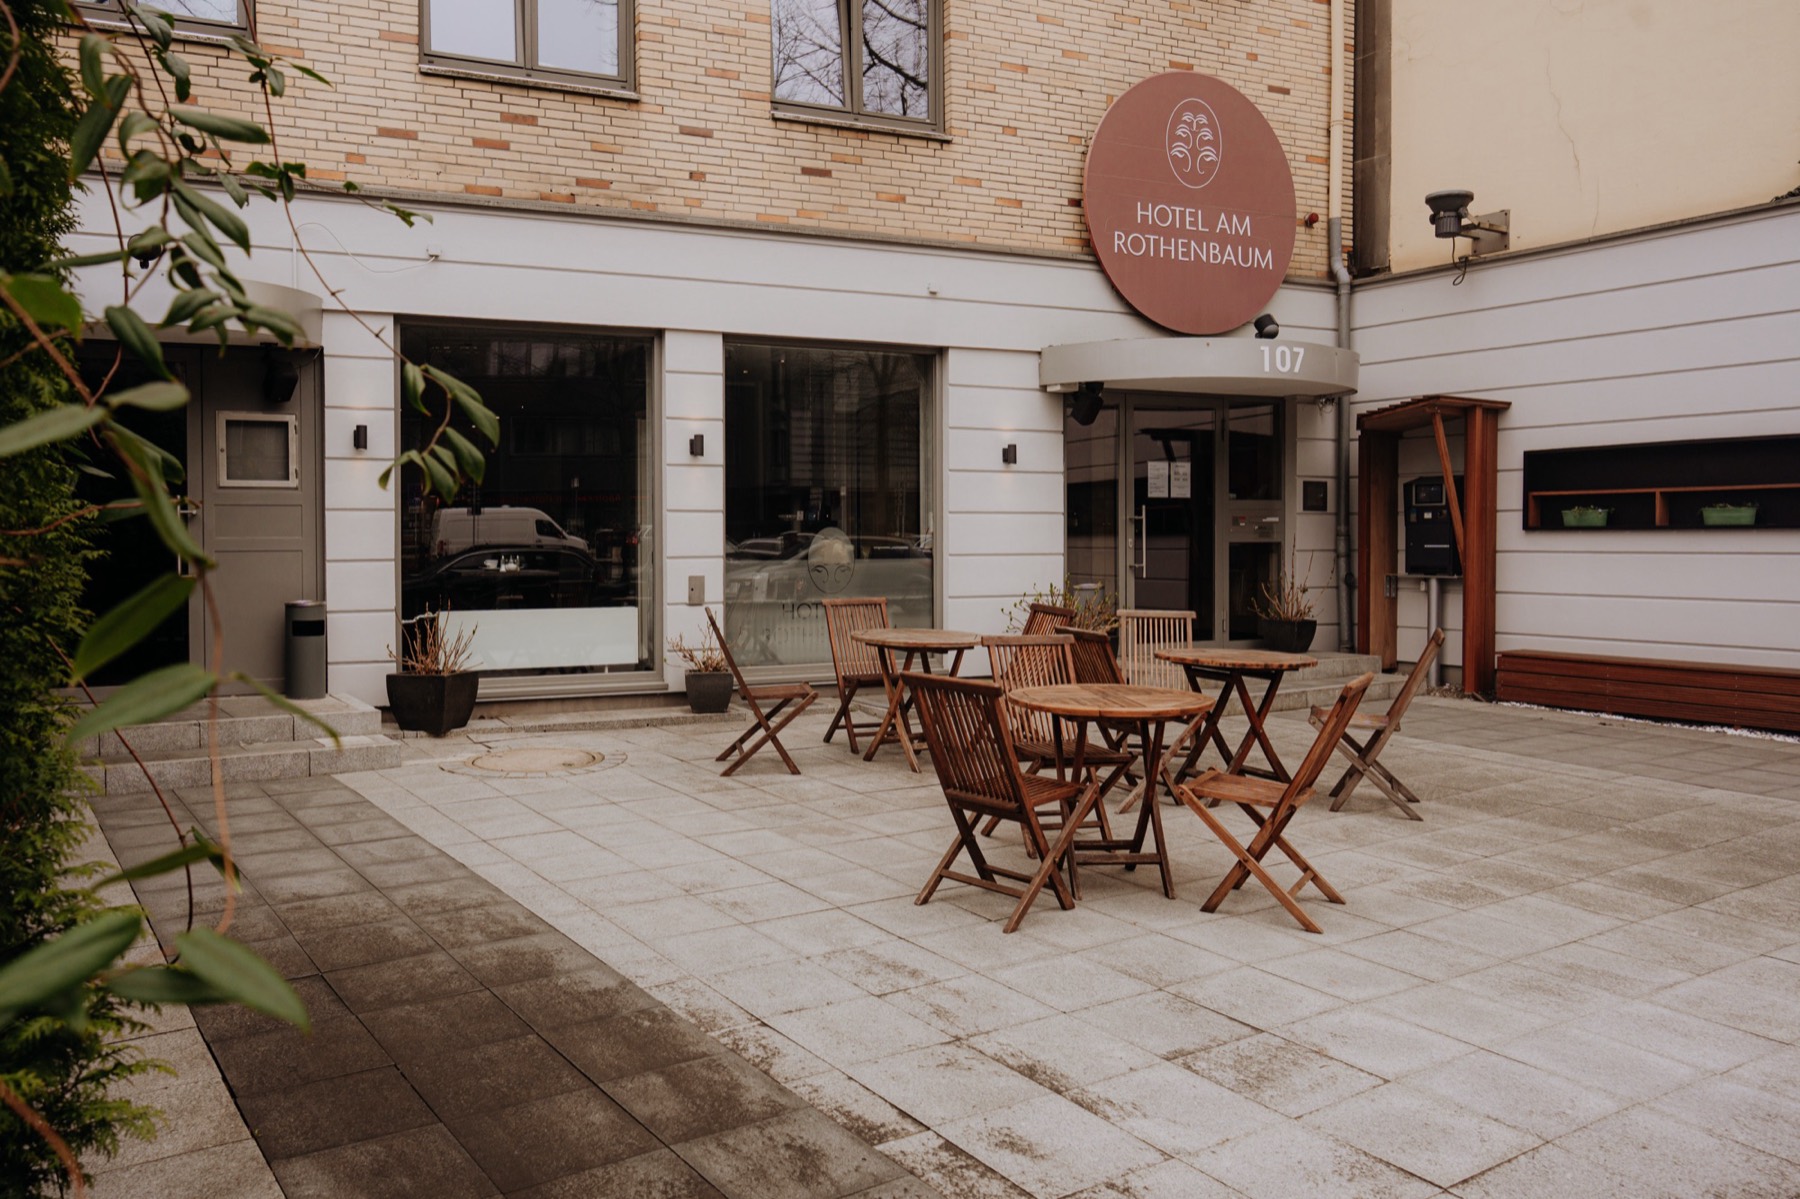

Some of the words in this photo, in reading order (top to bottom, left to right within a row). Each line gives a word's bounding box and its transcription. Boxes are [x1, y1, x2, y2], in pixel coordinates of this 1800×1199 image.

[1137, 202, 1209, 231] HOTEL
[1216, 212, 1251, 236] AM
[1114, 231, 1273, 270] ROTHENBAUM
[1260, 345, 1305, 373] 107
[782, 603, 822, 619] HOT
